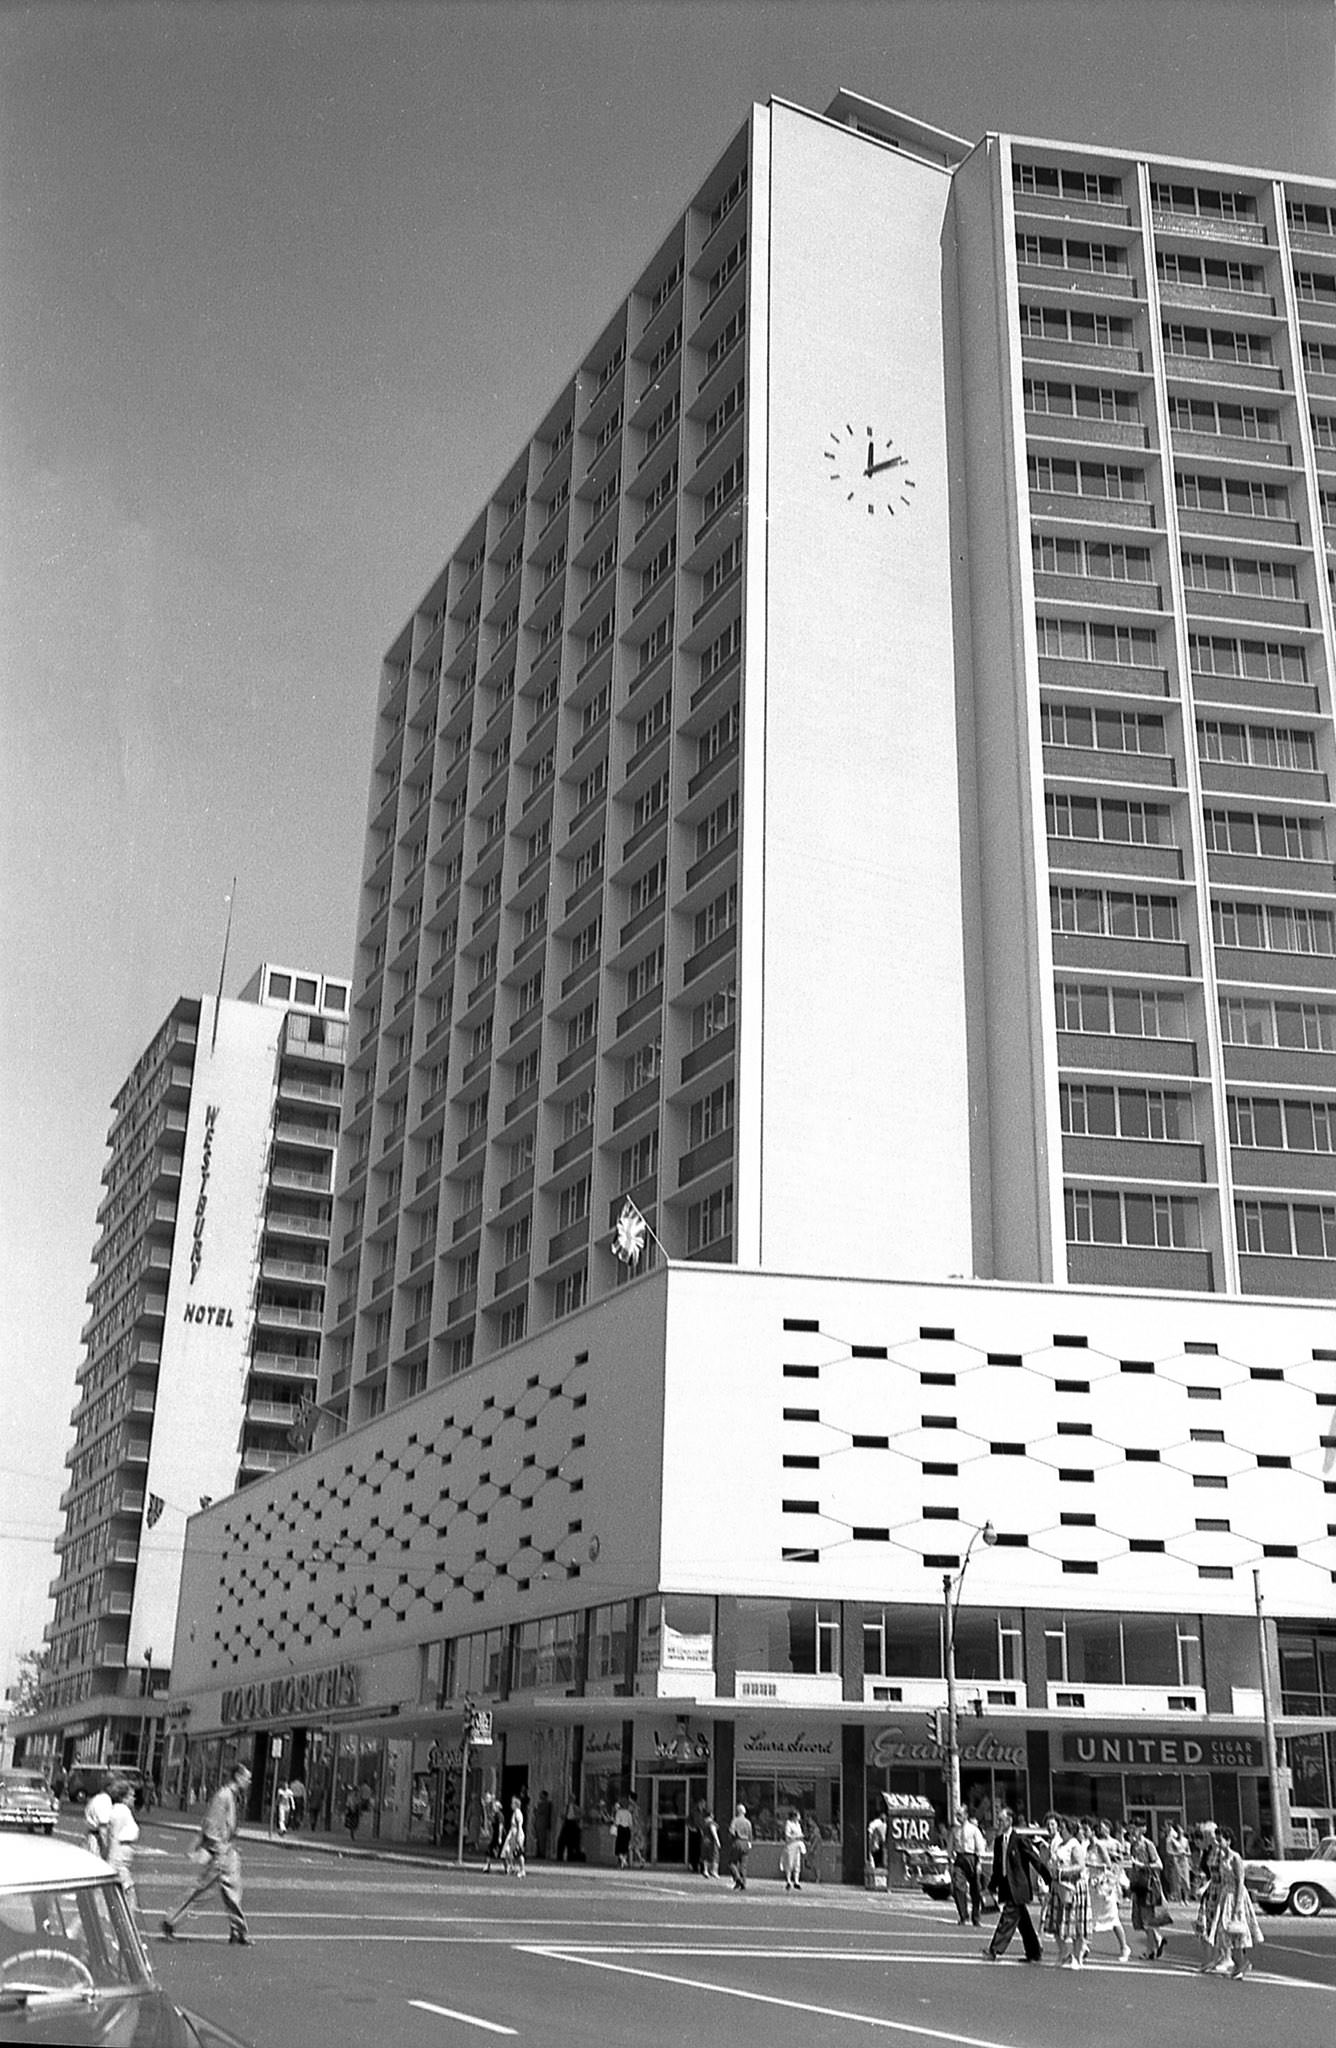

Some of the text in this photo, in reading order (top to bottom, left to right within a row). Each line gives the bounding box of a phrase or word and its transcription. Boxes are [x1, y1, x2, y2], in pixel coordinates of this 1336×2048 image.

[190, 1105, 220, 1285] WESTBURY
[183, 1303, 234, 1328] HOTEL
[873, 1727, 1027, 1768] Evaneline
[1076, 1737, 1203, 1764] UNITED
[1210, 1740, 1253, 1753] CIGAR
[1211, 1753, 1254, 1767] STORE
[891, 1817, 931, 1840] STAR
